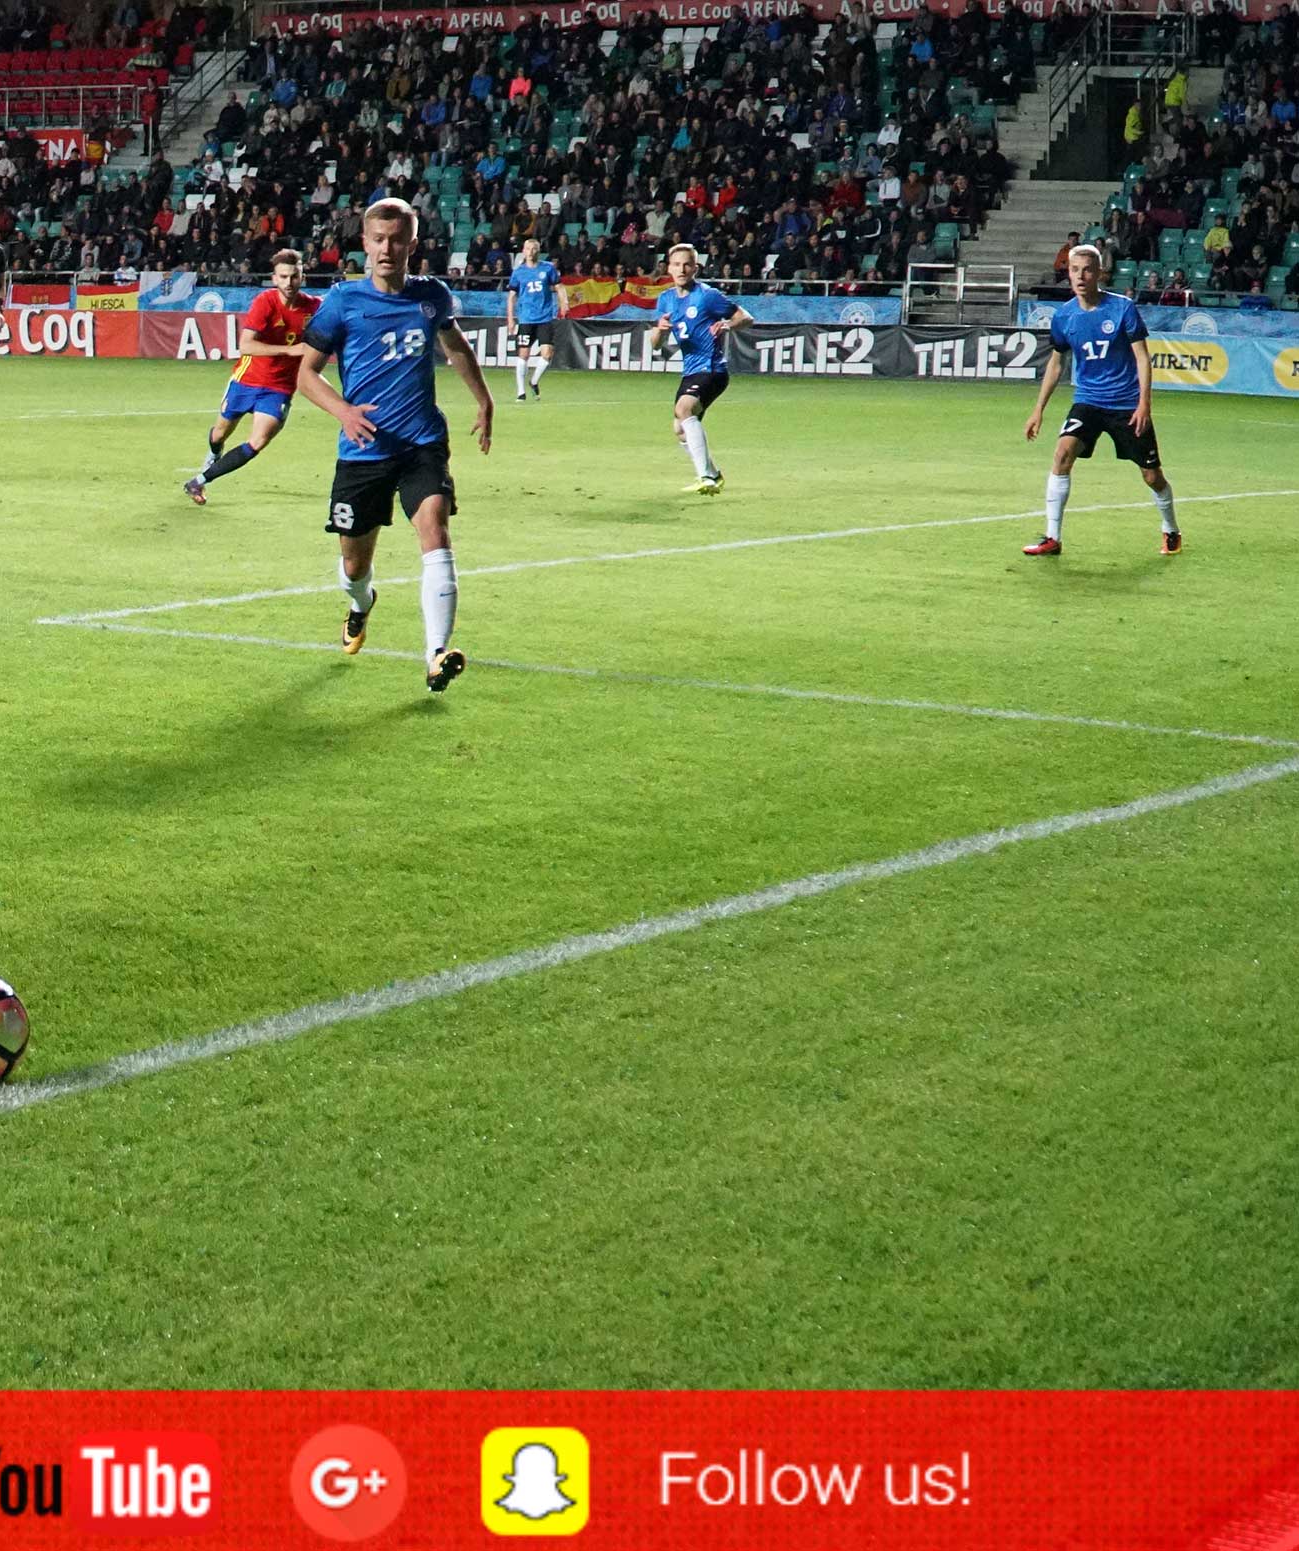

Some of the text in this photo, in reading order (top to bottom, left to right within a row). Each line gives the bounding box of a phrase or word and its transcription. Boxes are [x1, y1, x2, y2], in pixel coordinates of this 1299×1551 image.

[527, 280, 543, 293] 15
[18, 308, 95, 357] Coq
[518, 334, 531, 346] 15
[677, 321, 689, 339] 2
[381, 328, 427, 361] 18
[756, 327, 875, 375] TELE2
[913, 331, 1038, 379] TELE2
[1082, 340, 1110, 361] 17
[330, 502, 354, 530] 8
